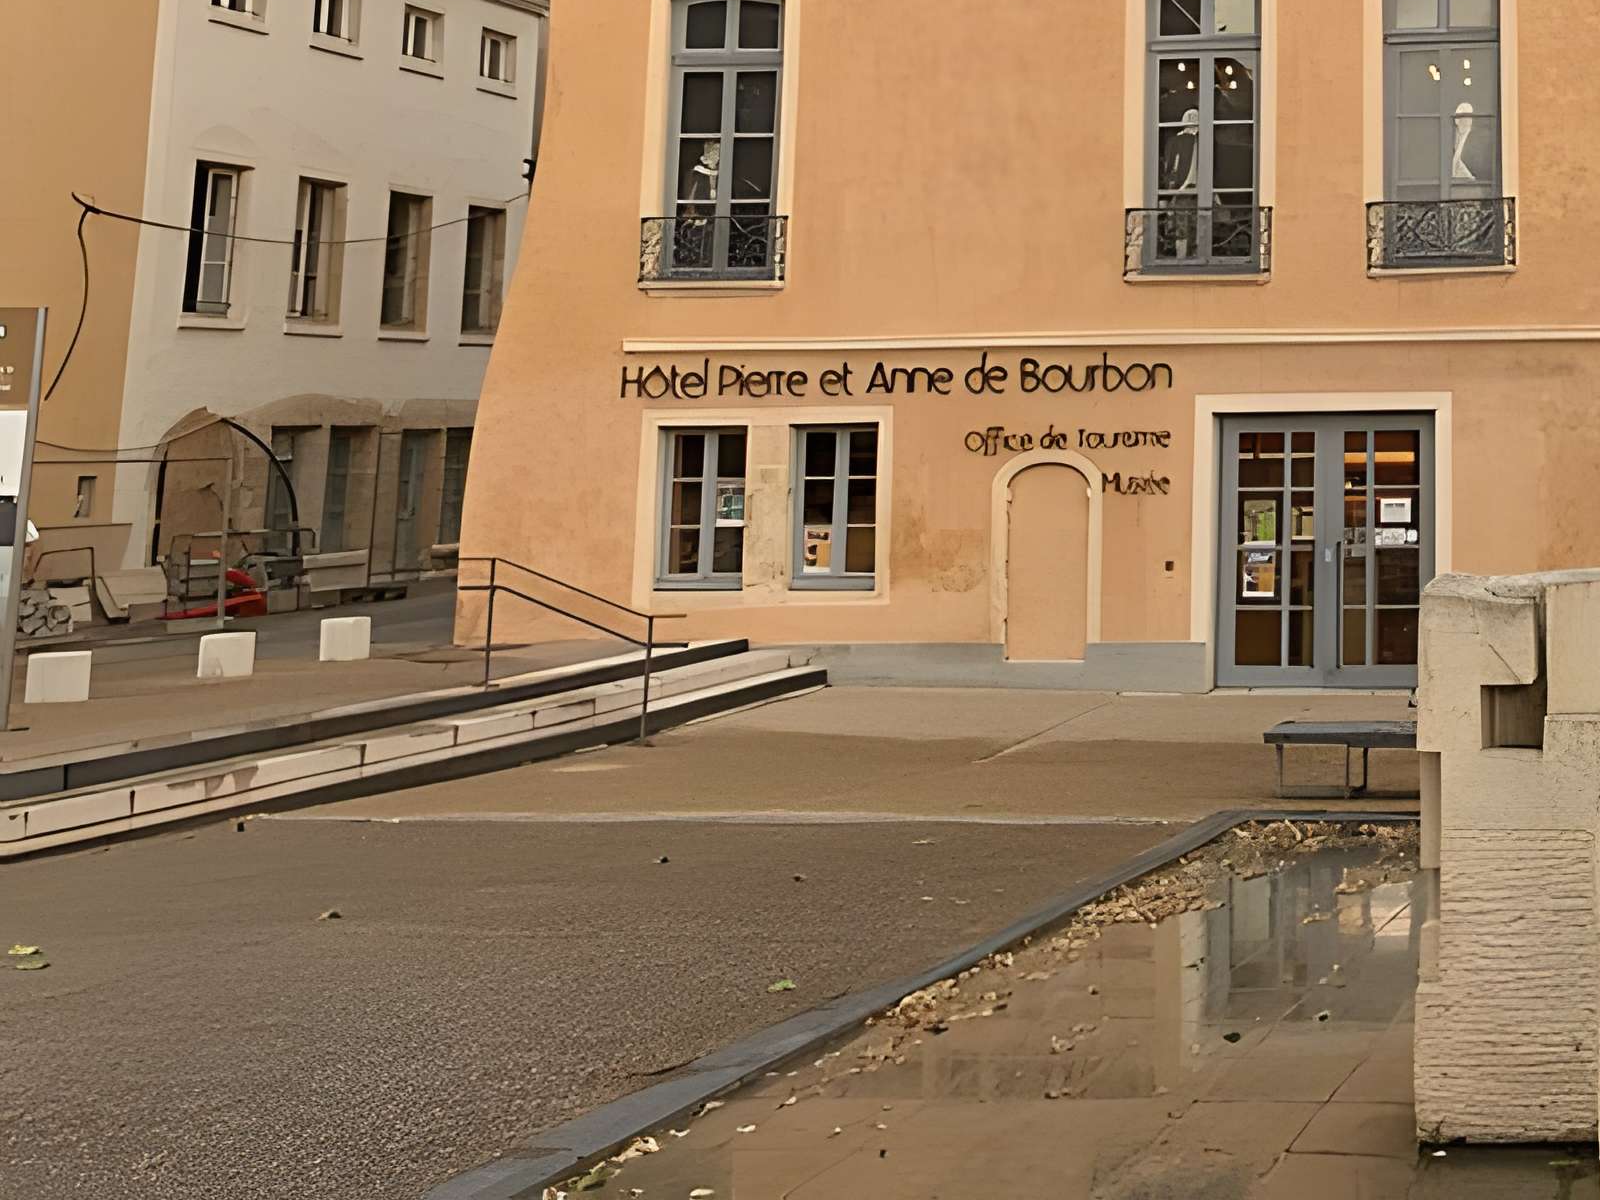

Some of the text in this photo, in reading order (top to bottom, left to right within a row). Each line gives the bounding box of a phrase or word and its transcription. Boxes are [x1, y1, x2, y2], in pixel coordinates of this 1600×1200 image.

[620, 351, 1172, 399] Hôtel Pierre et Anne de Bourbon
[1039, 424, 1068, 450] de
